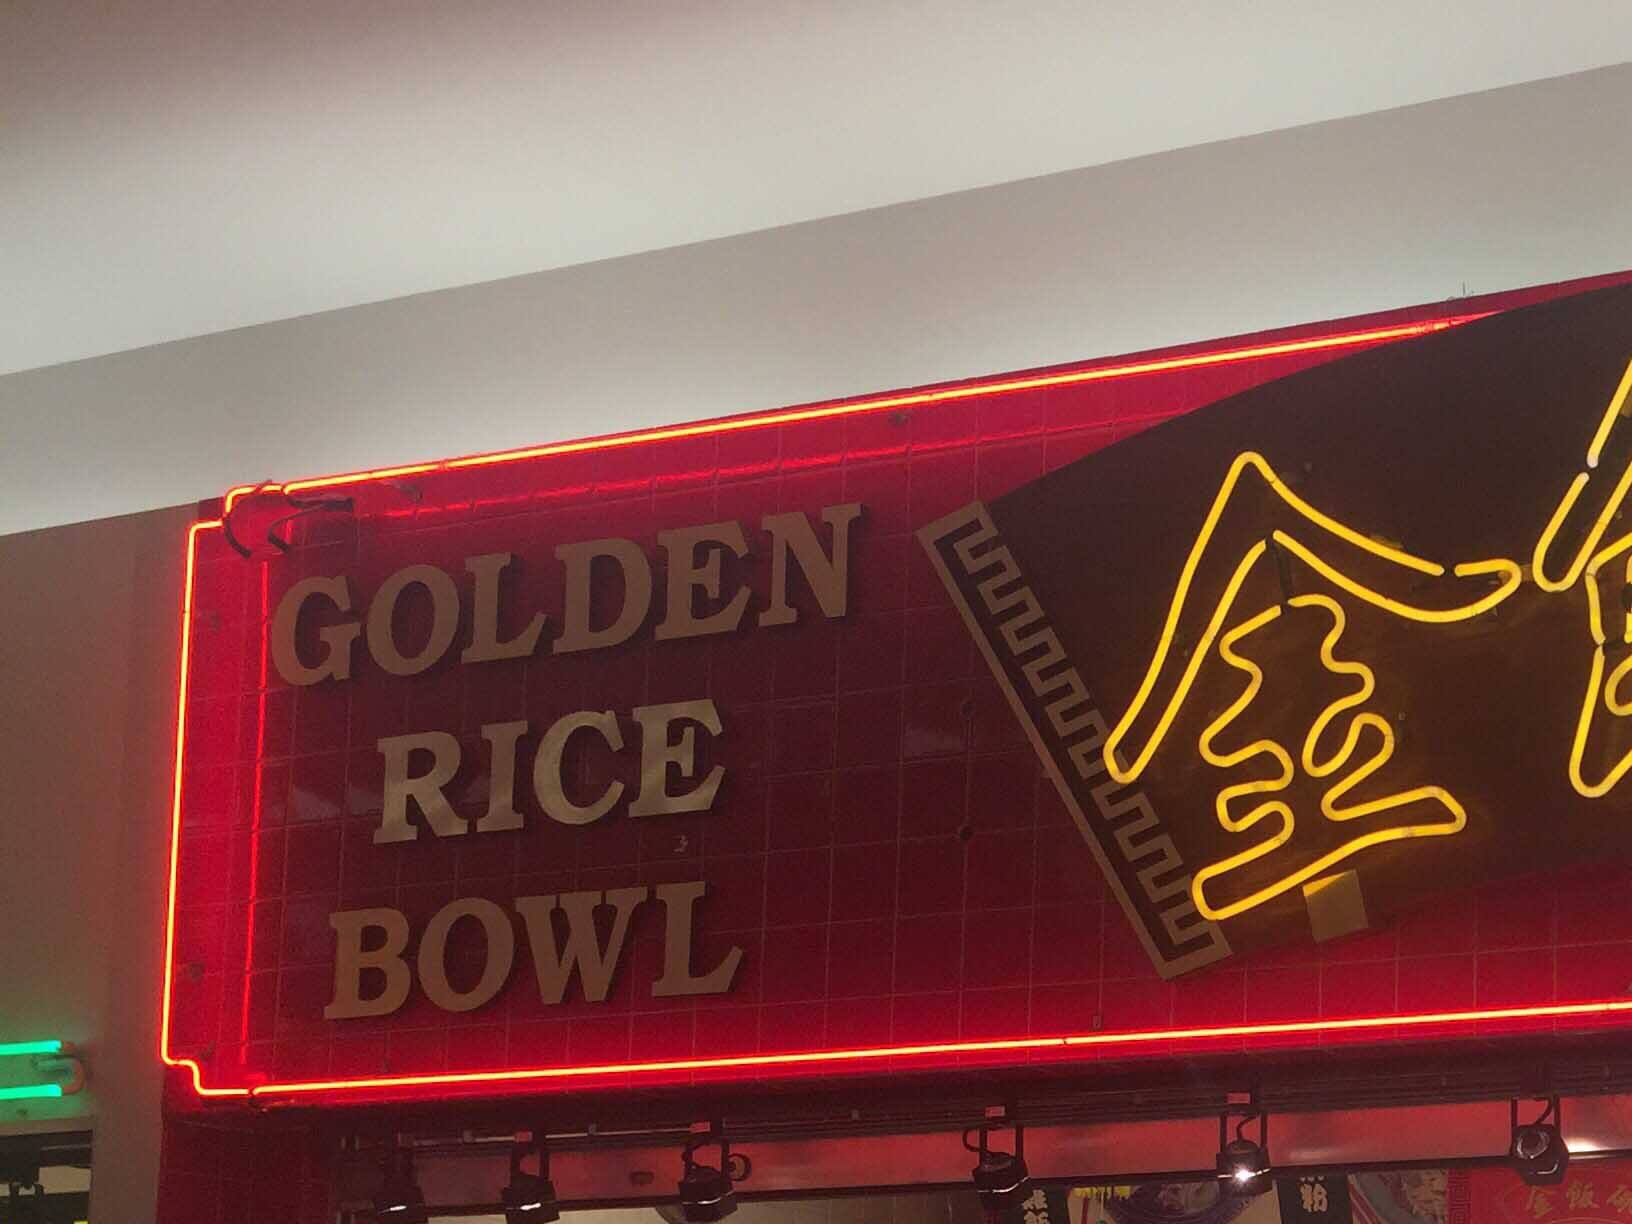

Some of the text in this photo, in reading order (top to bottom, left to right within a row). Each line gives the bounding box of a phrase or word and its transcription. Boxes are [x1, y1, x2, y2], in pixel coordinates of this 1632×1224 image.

[271, 502, 863, 687] GOLDEN
[372, 699, 725, 845] RICE
[323, 880, 743, 1020] BOWL
